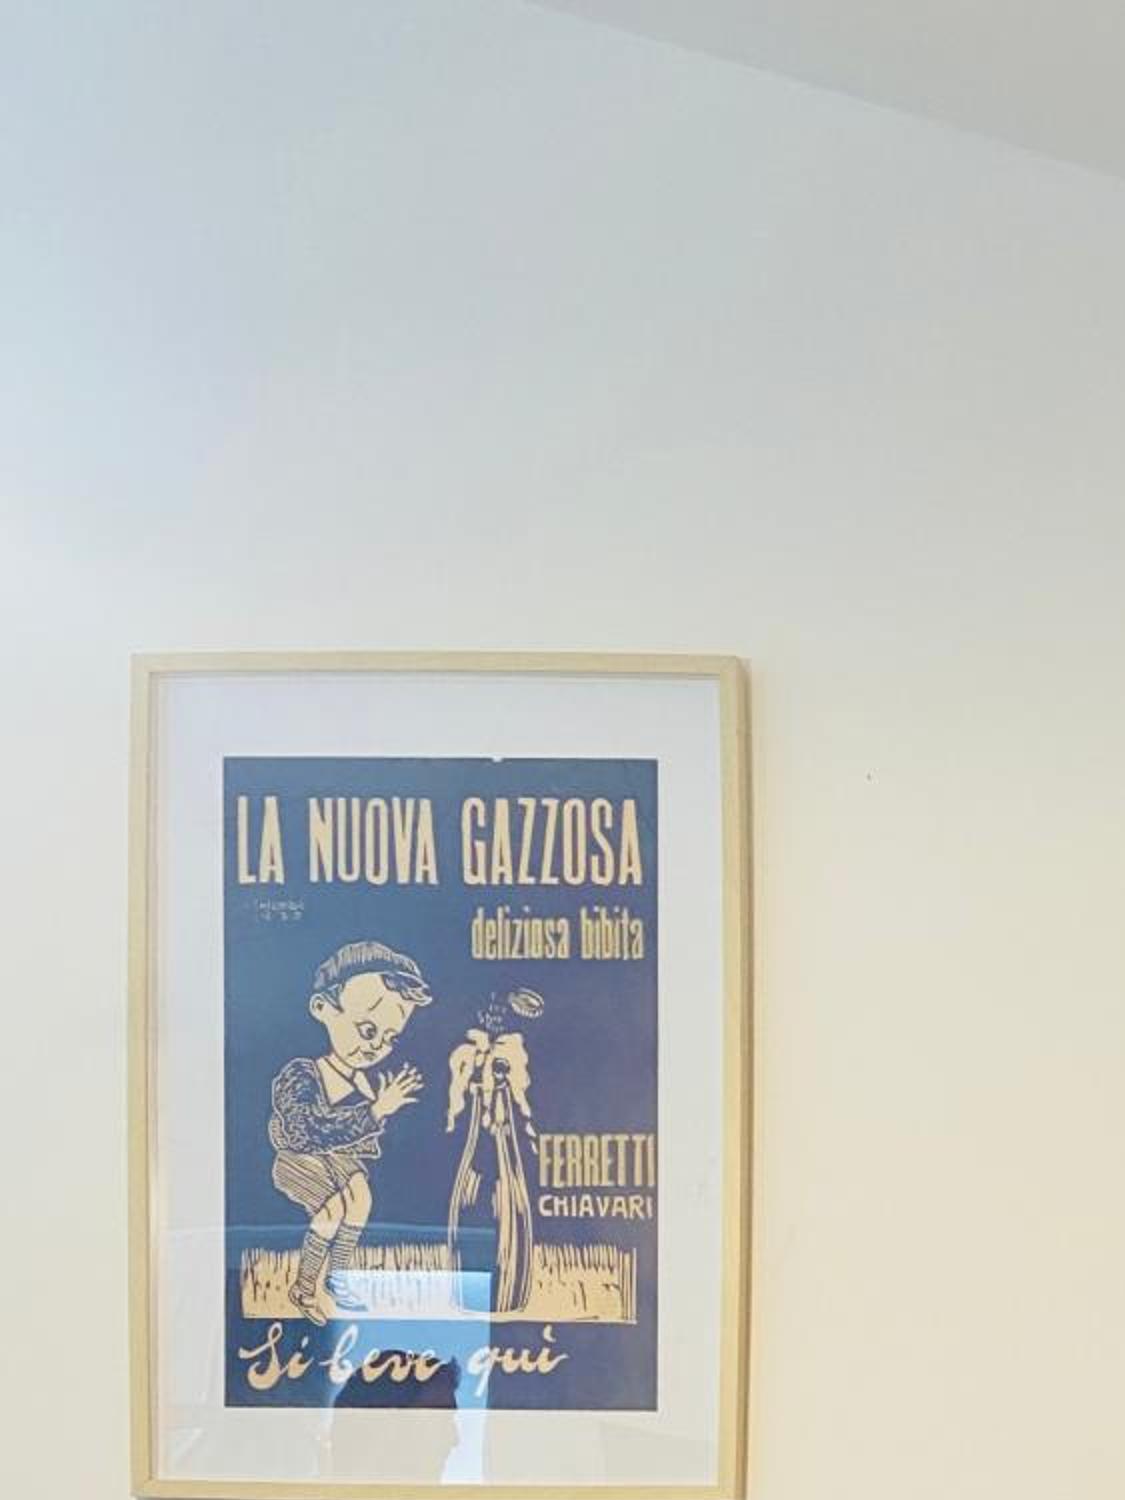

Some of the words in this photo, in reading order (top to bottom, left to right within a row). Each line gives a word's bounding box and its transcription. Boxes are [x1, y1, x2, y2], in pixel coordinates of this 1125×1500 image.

[237, 796, 285, 885] LA
[309, 797, 438, 885] NUOVA
[461, 798, 643, 886] GAZZOSA
[471, 905, 570, 960] deliziosa
[580, 905, 645, 960] bibita
[538, 1133, 656, 1188] FERRETTI
[538, 1194, 654, 1219] CHIAVARI
[238, 1321, 314, 1391] Si
[318, 1324, 446, 1384] beve
